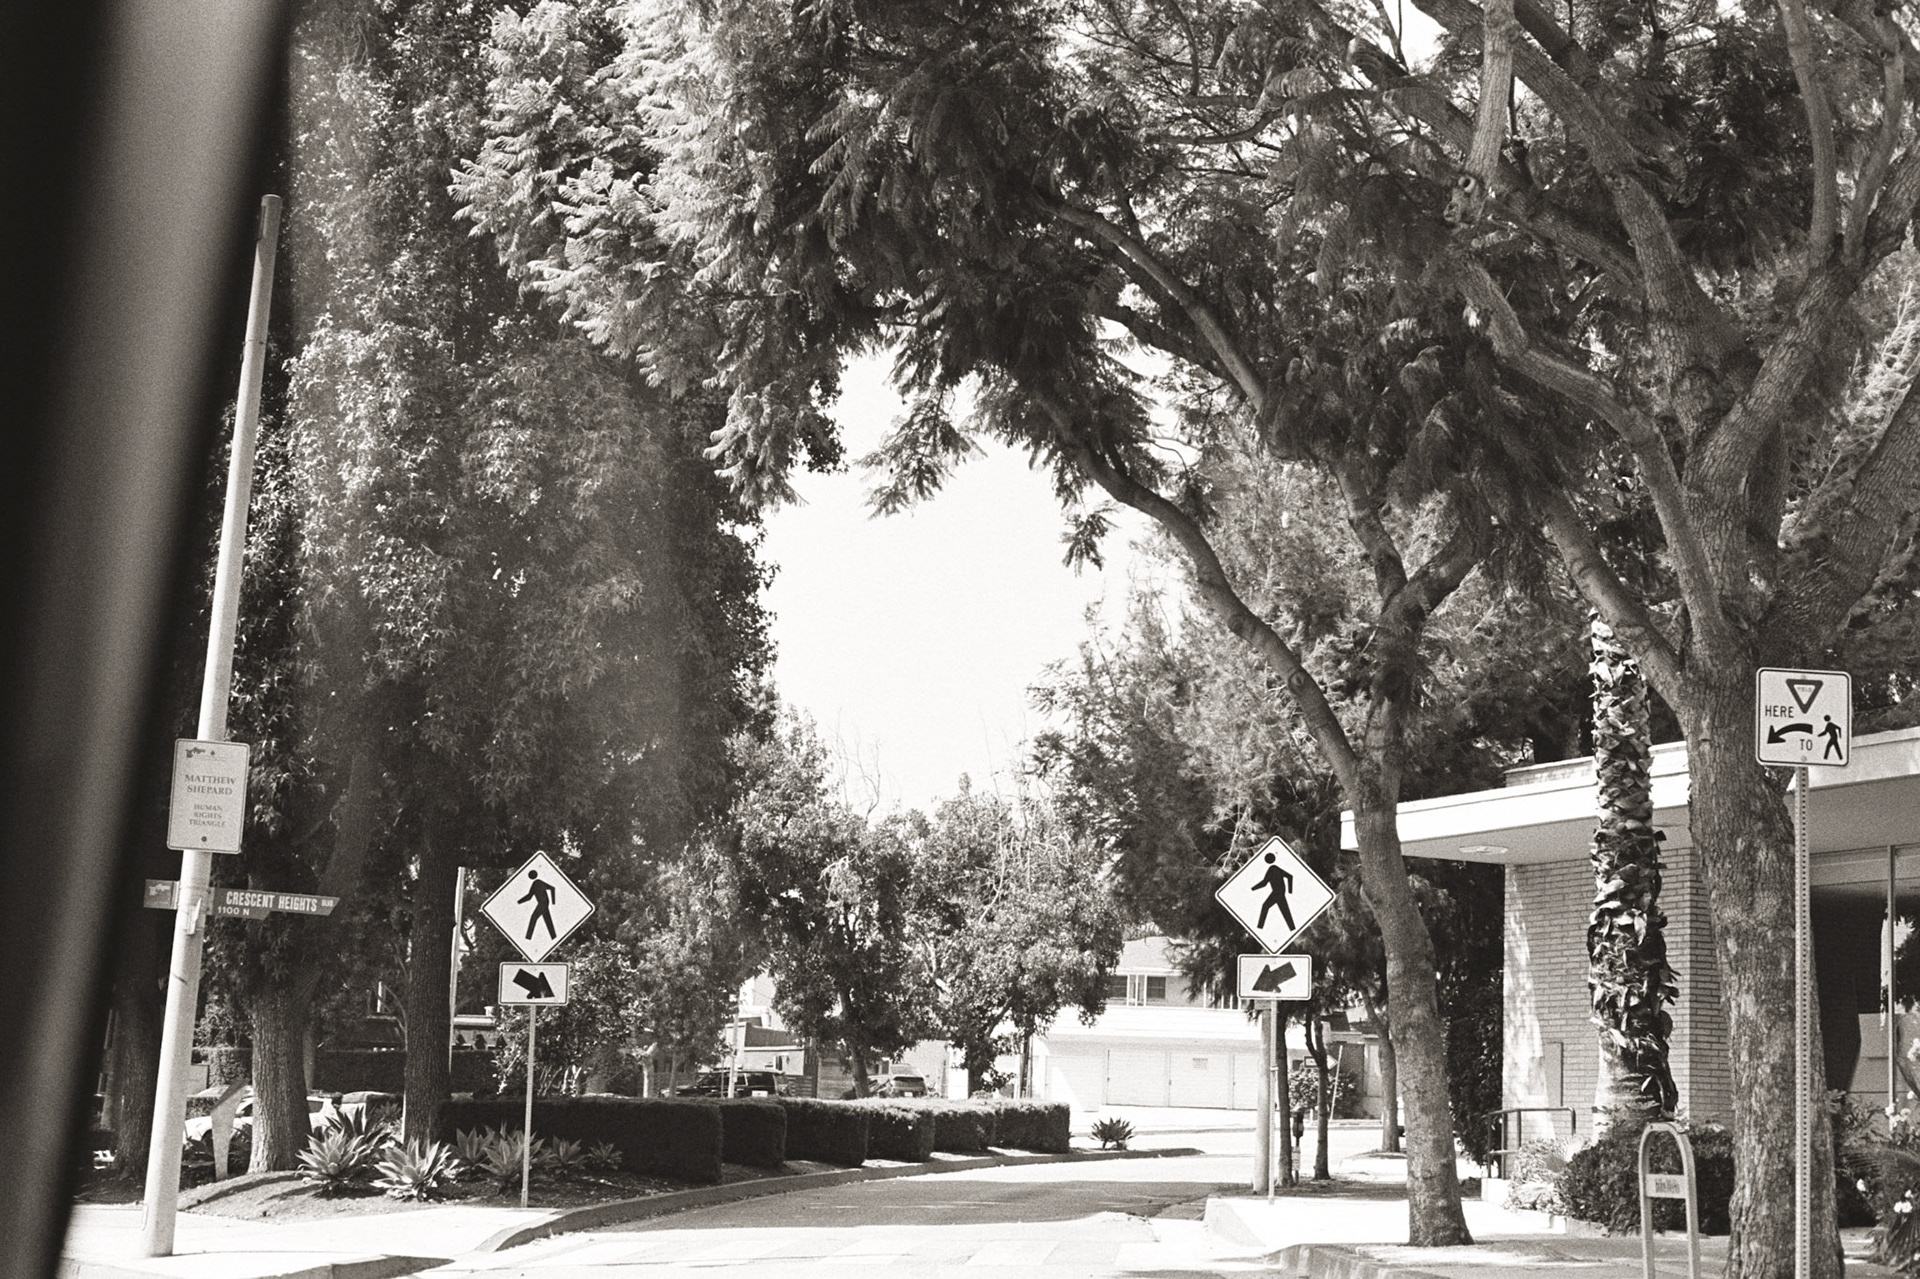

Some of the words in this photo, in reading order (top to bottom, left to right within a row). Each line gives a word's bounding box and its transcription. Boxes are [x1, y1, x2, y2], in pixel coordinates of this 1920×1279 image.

[1764, 705, 1795, 718] HERE
[1799, 738, 1813, 751] TO
[185, 774, 236, 785] MATTHEW
[186, 785, 233, 796] SHEPARD
[193, 804, 223, 812] HUMAN
[189, 819, 226, 827] TRIANGLE
[226, 891, 275, 909] CRESCENT
[278, 895, 318, 912] HEIGHTS
[217, 906, 240, 915] 1100
[242, 908, 250, 916] N
